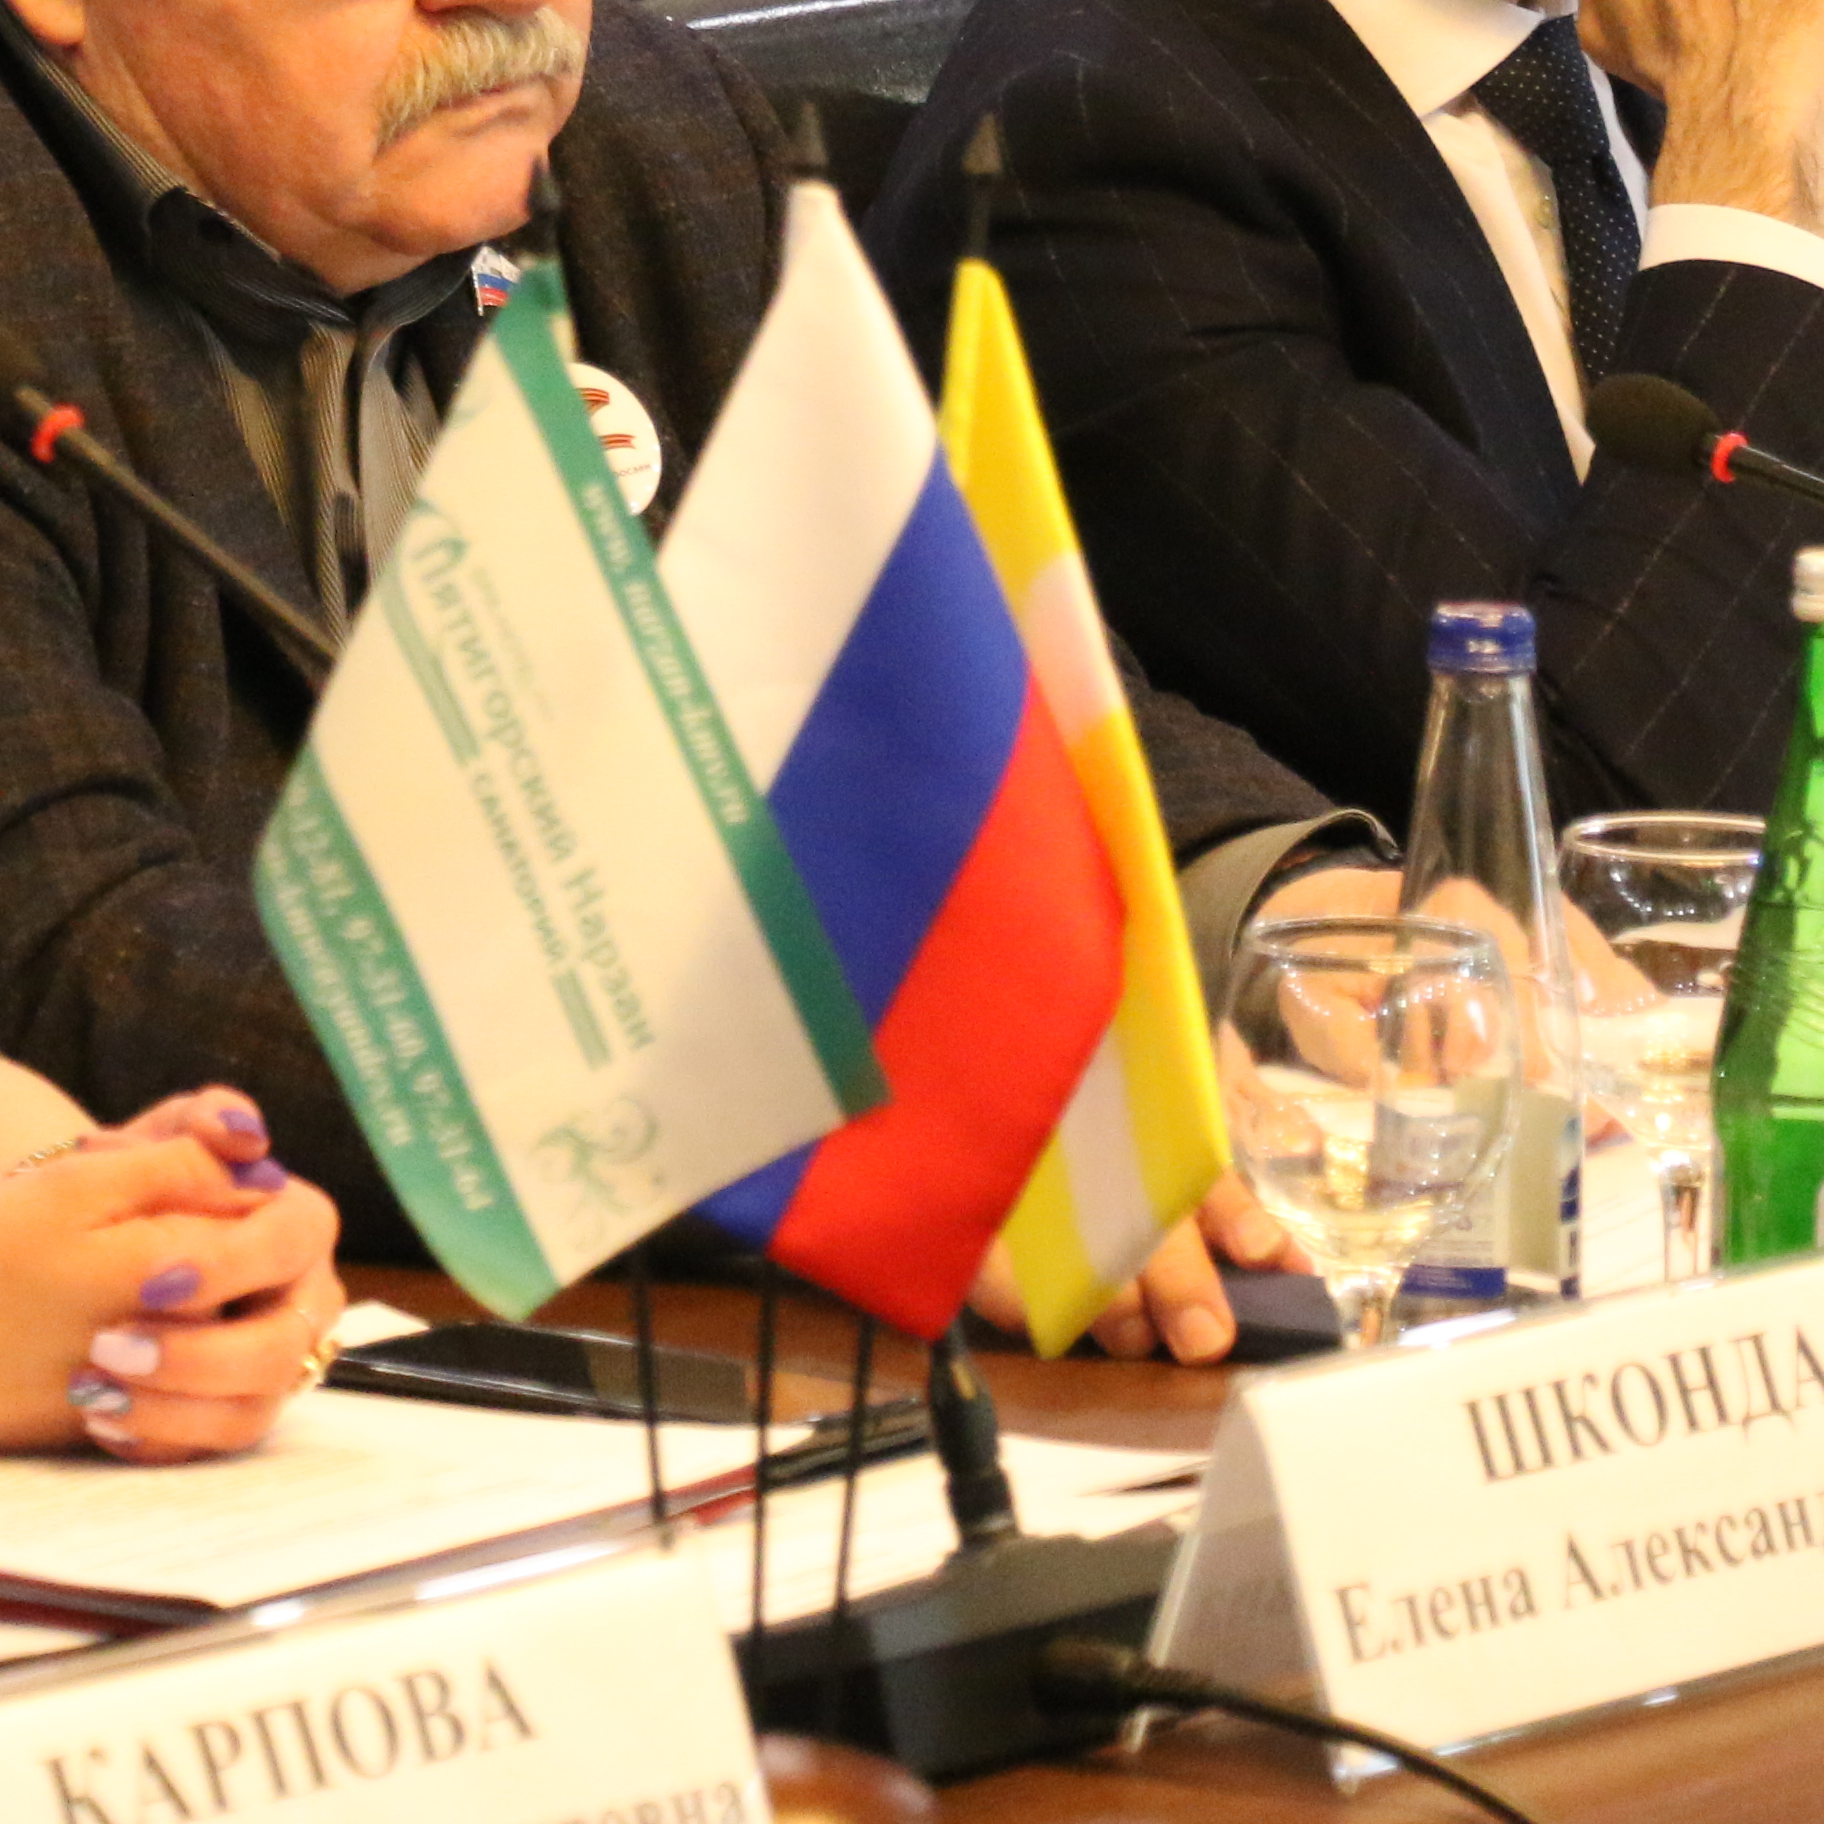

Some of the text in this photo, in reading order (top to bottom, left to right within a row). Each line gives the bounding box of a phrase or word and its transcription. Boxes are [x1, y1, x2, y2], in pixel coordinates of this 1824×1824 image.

[408, 536, 661, 1054] Пятигорский Нарзан
[464, 769, 571, 970] САНАТОРИЙ
[1331, 1577, 1539, 1668] Елена
[42, 1655, 539, 1824] КАРПОВА
